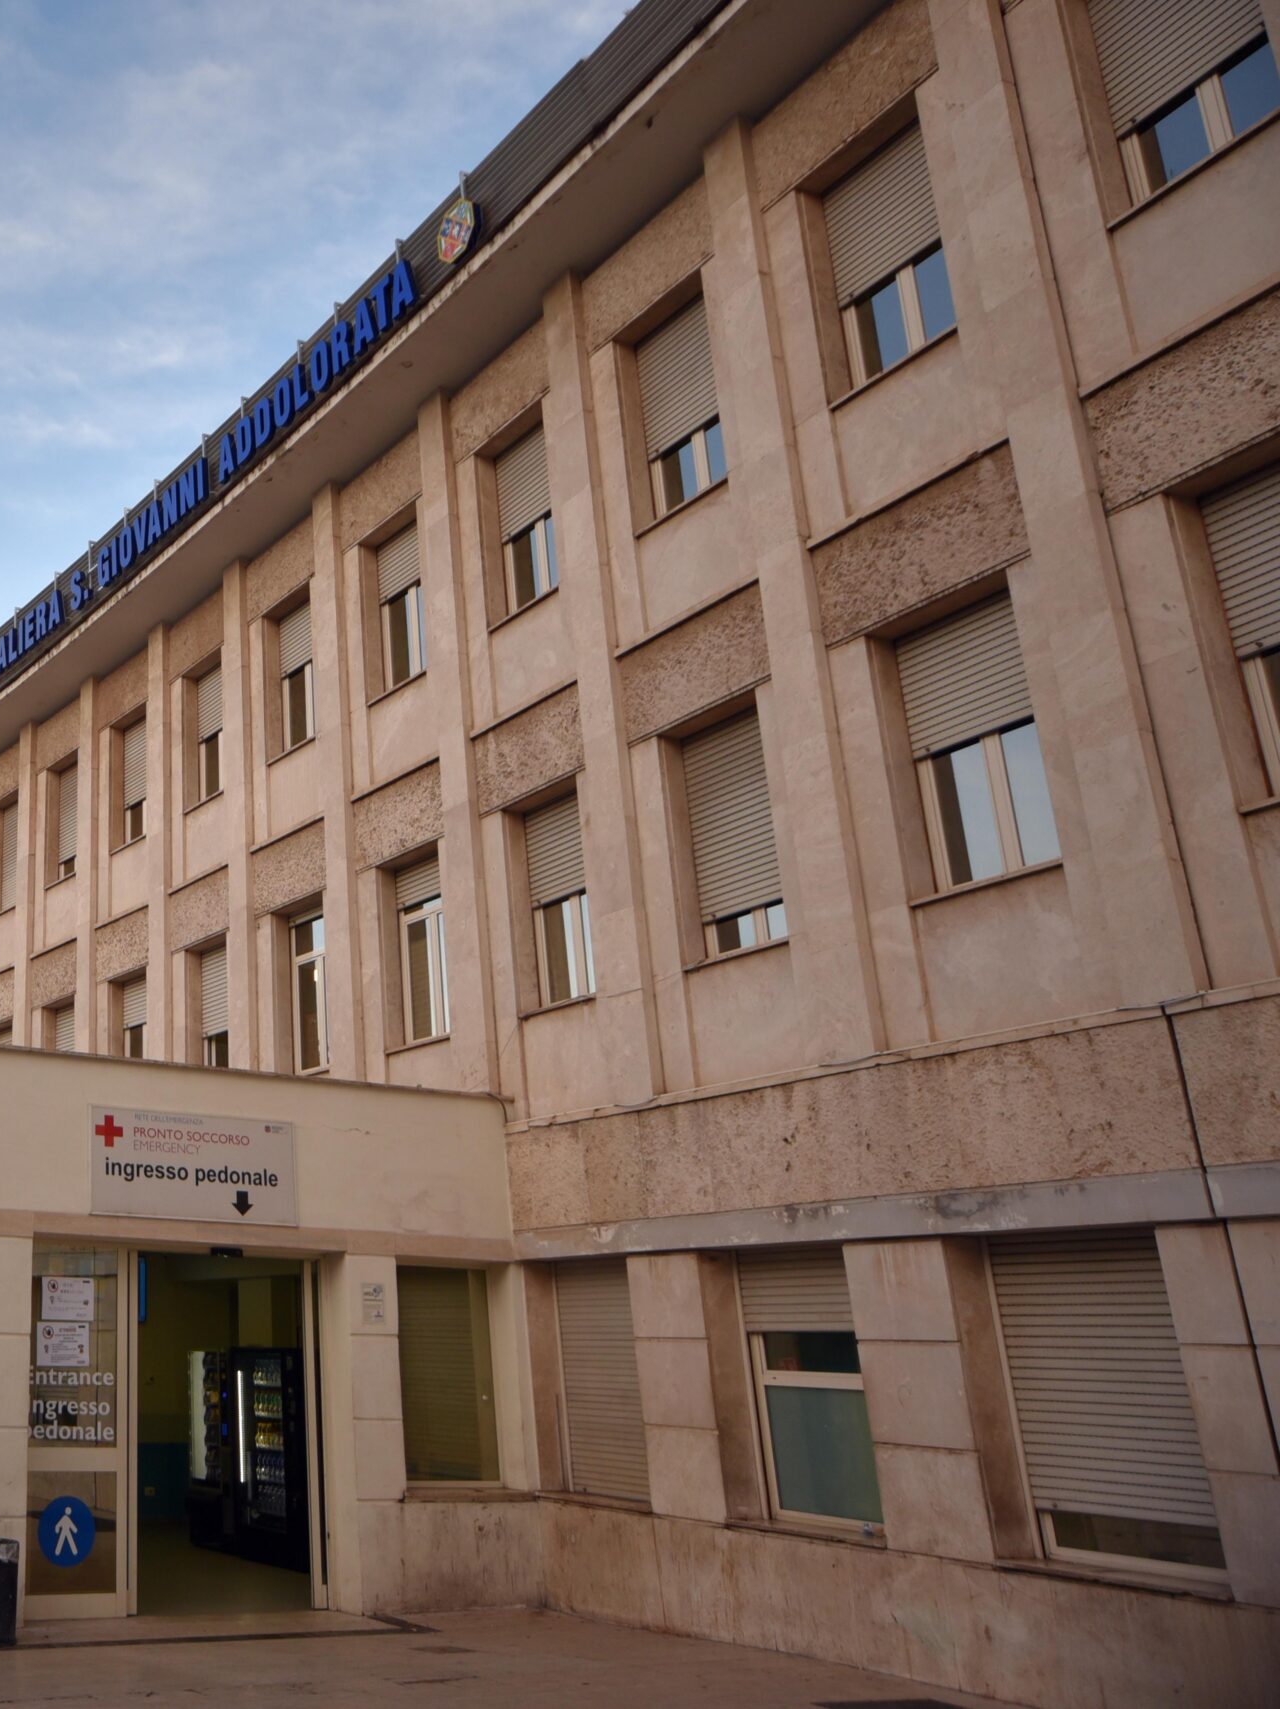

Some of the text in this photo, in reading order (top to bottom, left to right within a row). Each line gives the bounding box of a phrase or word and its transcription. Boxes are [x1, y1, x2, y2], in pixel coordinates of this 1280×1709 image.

[70, 569, 93, 611] S.
[97, 456, 209, 588] GIOVANNI
[219, 258, 420, 484] ADDOLORATA
[133, 1127, 250, 1146] PRONTO SOCCORSO
[133, 1140, 201, 1156] EMERGENCY
[105, 1157, 279, 1187] ingresso pedonale
[30, 1366, 115, 1386] ntrance
